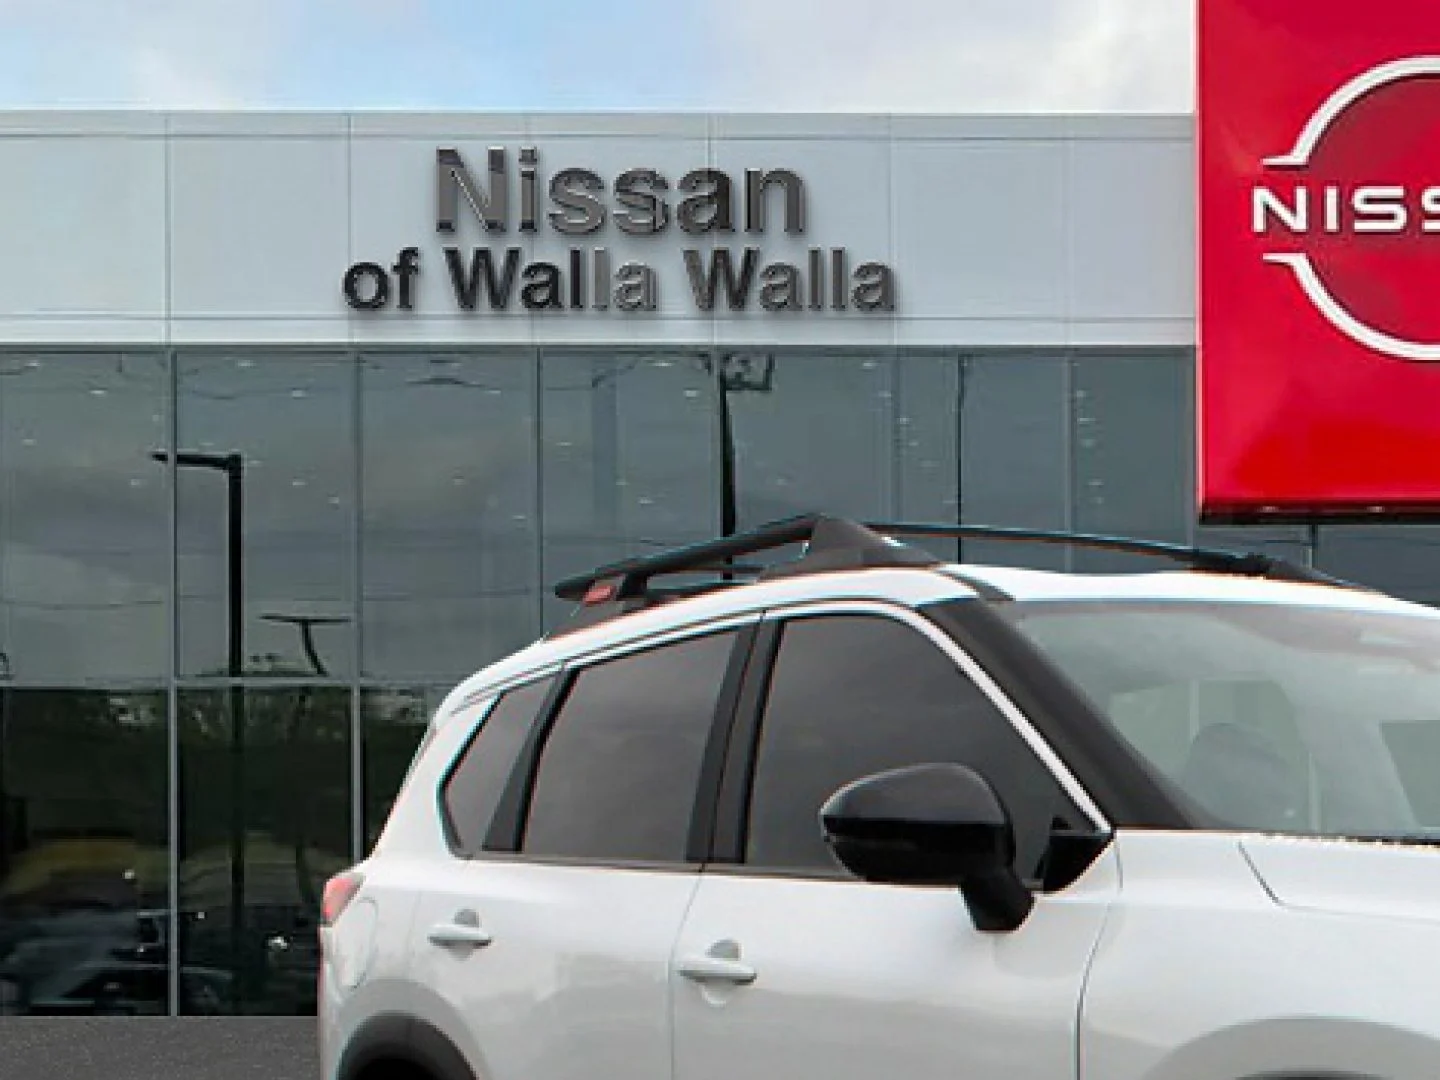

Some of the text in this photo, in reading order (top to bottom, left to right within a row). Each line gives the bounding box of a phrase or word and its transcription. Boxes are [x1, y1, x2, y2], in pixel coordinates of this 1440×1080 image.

[435, 146, 806, 234] Nissan
[343, 246, 896, 312] of Walla Walla
